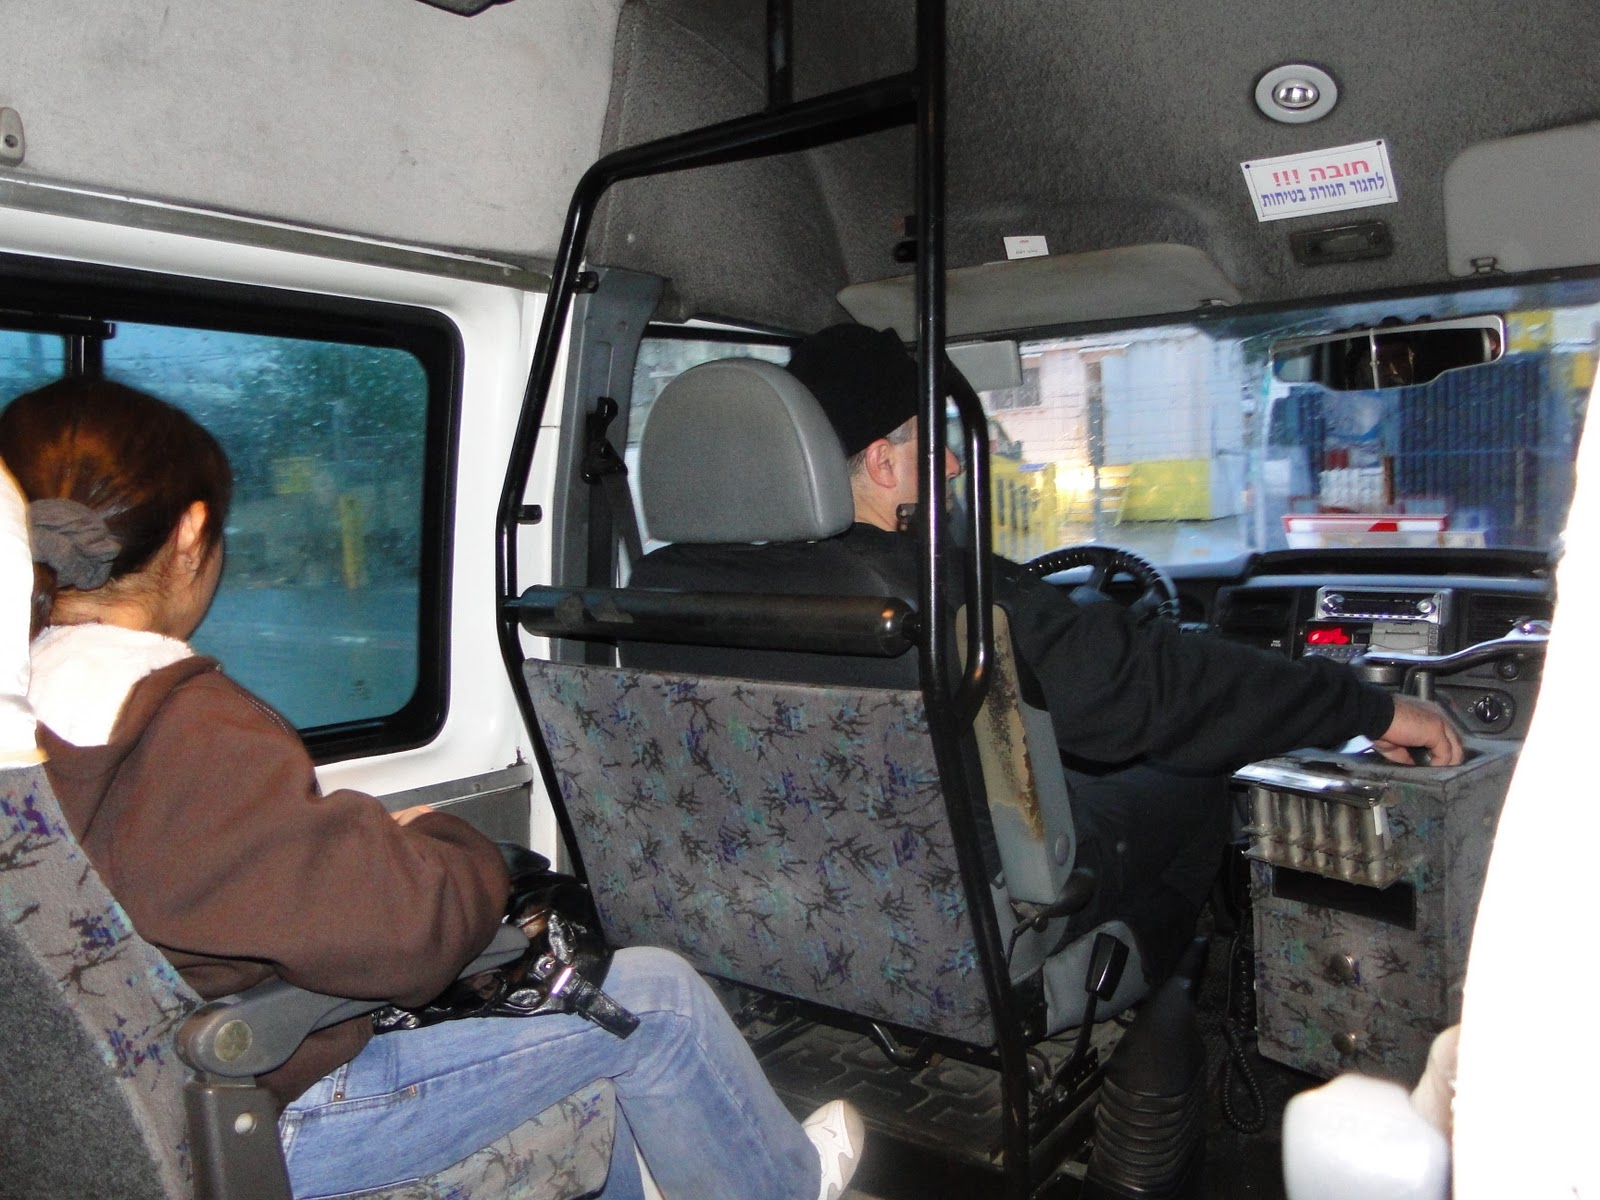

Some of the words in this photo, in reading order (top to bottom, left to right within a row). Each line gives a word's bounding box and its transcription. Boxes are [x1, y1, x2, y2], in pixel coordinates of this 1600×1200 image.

[1272, 169, 1300, 187] !!!
[1309, 160, 1370, 182] חובה
[1309, 181, 1346, 200] חגורת
[1349, 171, 1385, 194] לחגור
[1261, 188, 1306, 207] בטיחות
